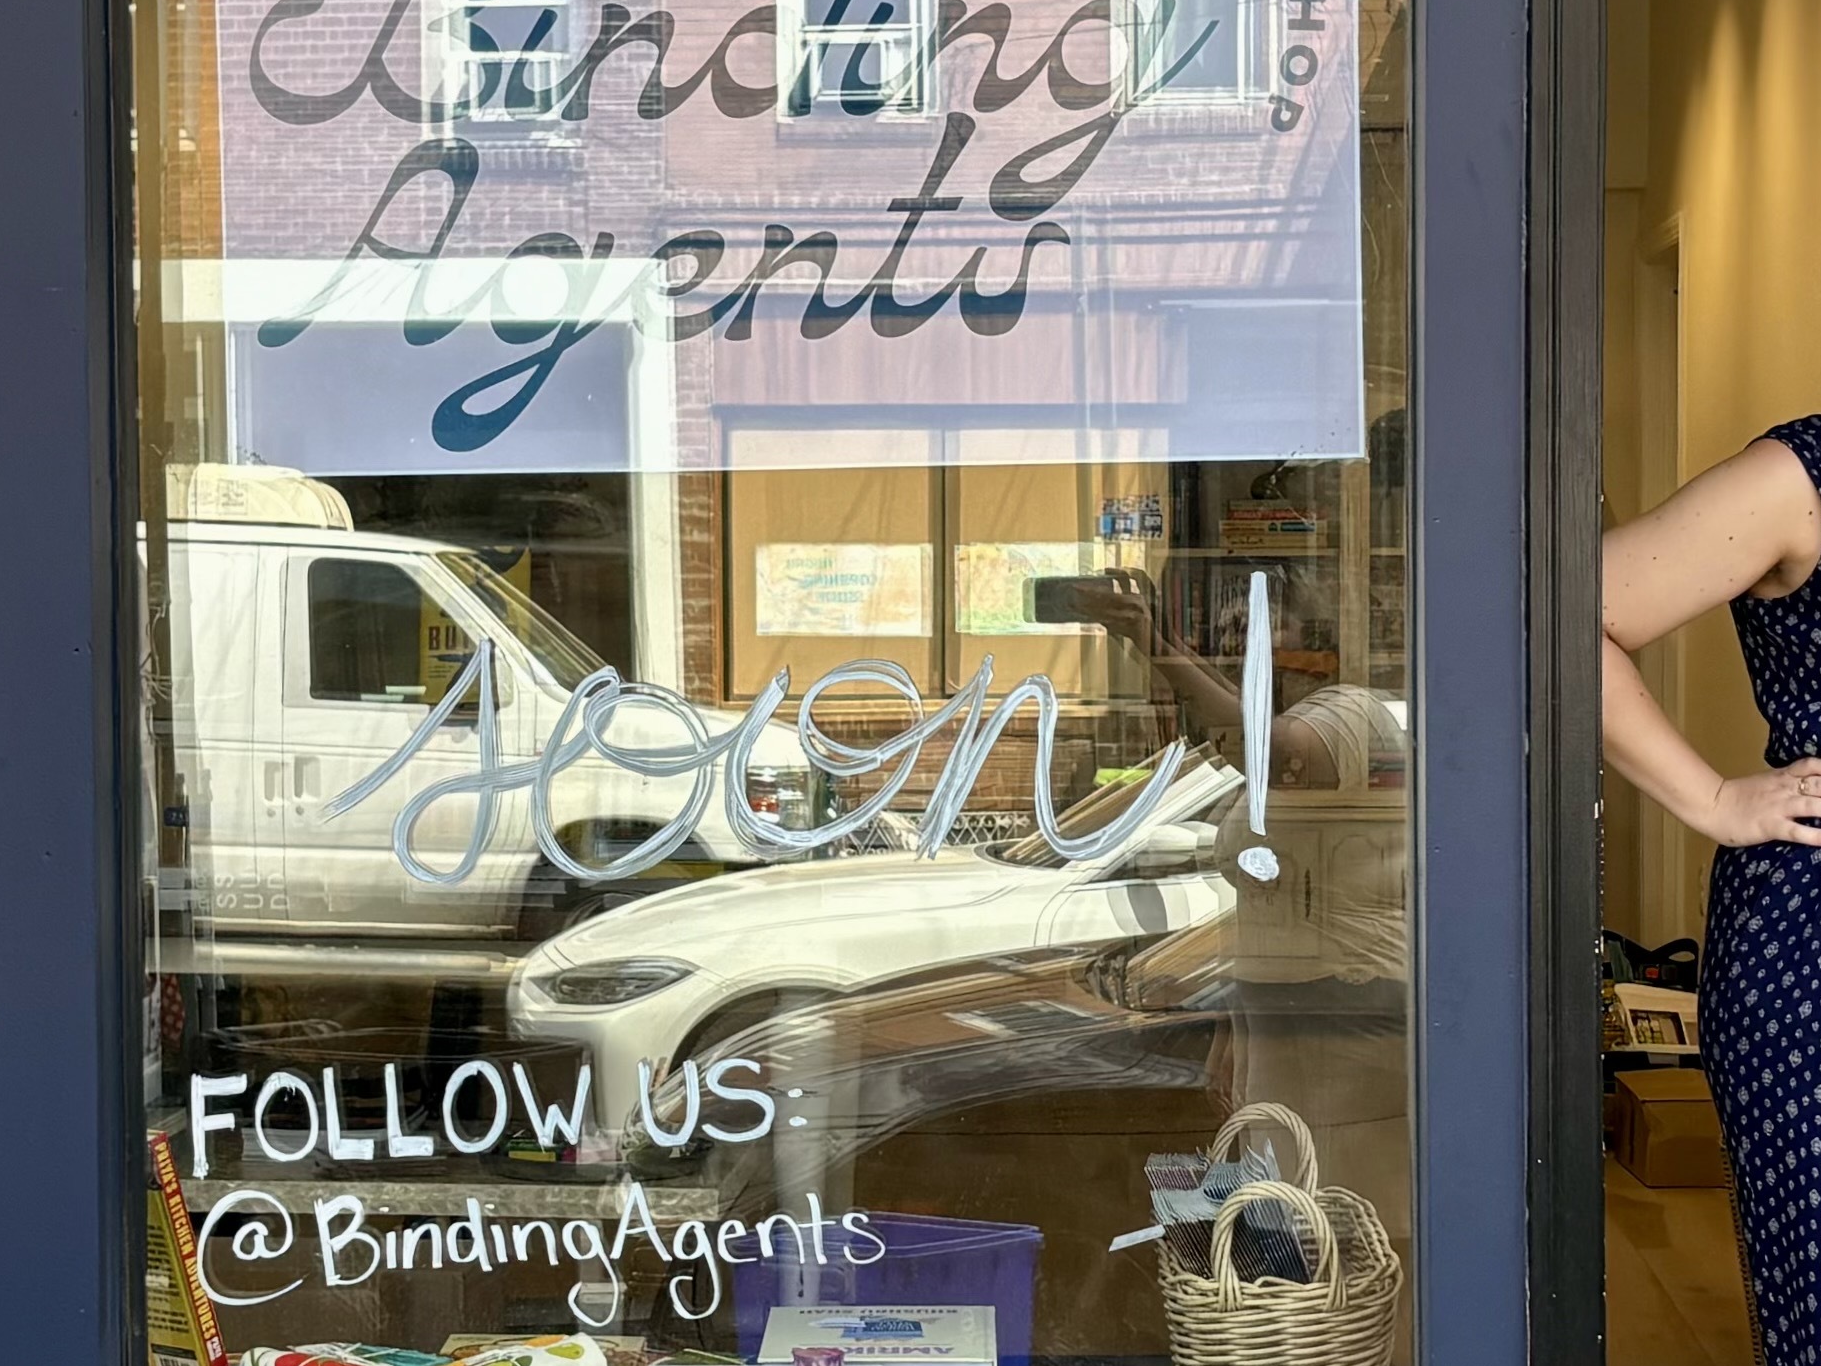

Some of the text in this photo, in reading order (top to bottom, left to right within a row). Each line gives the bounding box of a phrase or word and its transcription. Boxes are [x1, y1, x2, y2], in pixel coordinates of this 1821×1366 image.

[257, 111, 1070, 454] Agents
[190, 1057, 809, 1179] FOLLOW US:
[153, 1141, 175, 1194] PRIYA'S
[168, 1193, 195, 1257] KITCHEN
[183, 1255, 217, 1341] ADVENTURES
[197, 1179, 888, 1328] @BindingAgents
[842, 1346, 955, 1355] AMRIK
